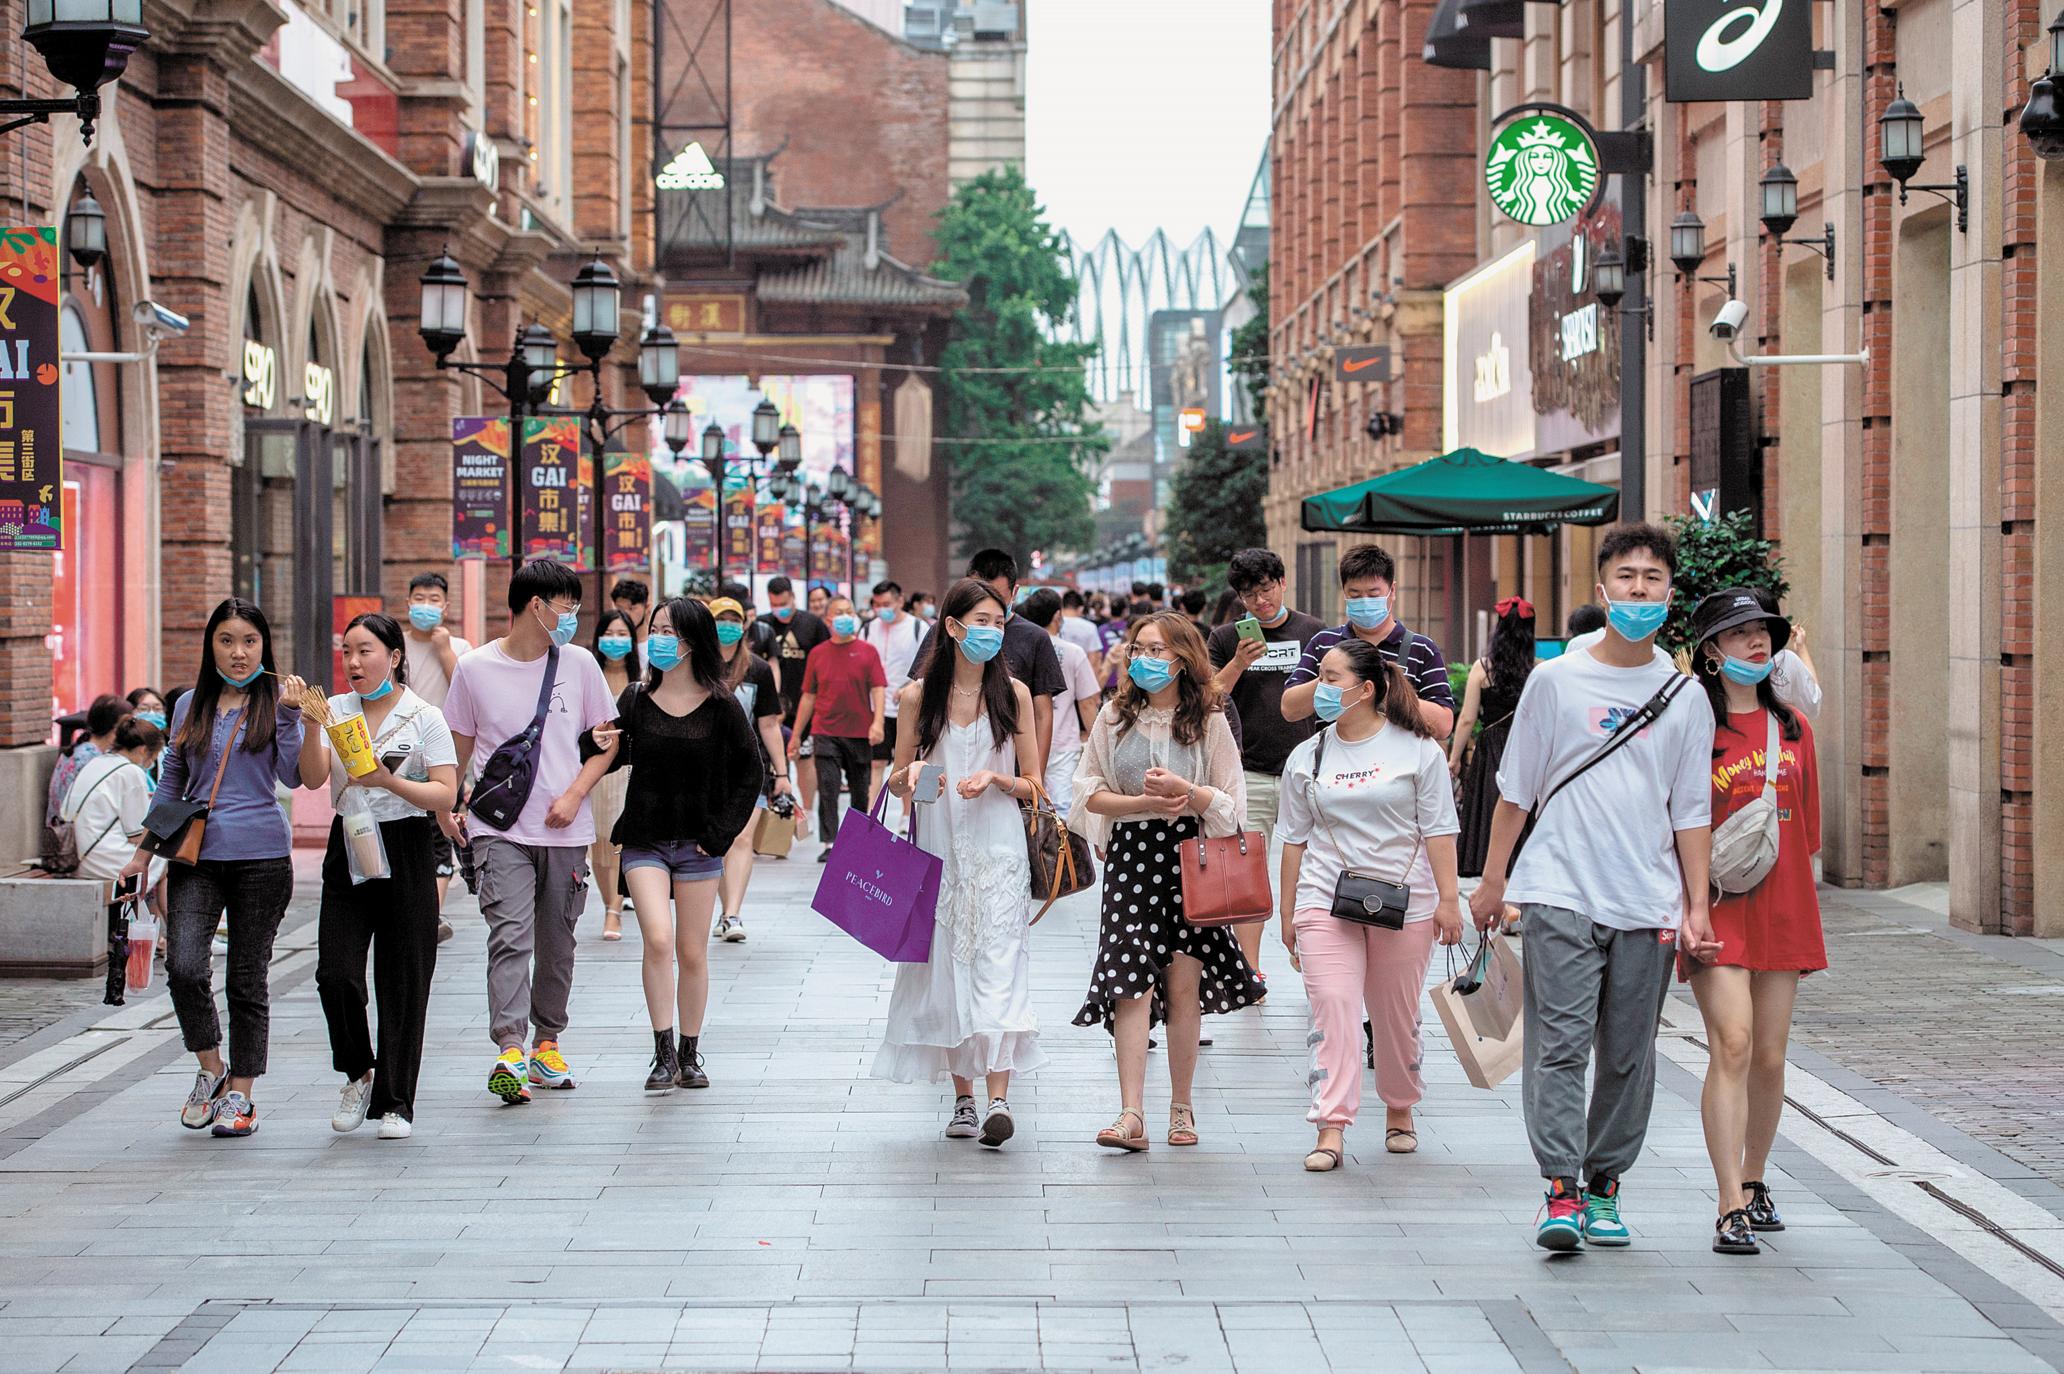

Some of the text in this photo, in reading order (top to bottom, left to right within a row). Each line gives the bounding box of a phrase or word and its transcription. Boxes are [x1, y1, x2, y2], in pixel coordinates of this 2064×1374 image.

[656, 173, 725, 190] adidas
[0, 339, 30, 379] AI
[21, 429, 35, 482] 第三街区
[462, 455, 499, 465] NIGHT
[456, 466, 505, 478] MARKET
[531, 466, 568, 487] GAI
[611, 494, 642, 511] GAI
[1564, 508, 1604, 518] COFFEE
[1335, 770, 1374, 780] CHERRY
[1712, 756, 1752, 793] Money
[845, 871, 893, 906] PEACEBIRD
